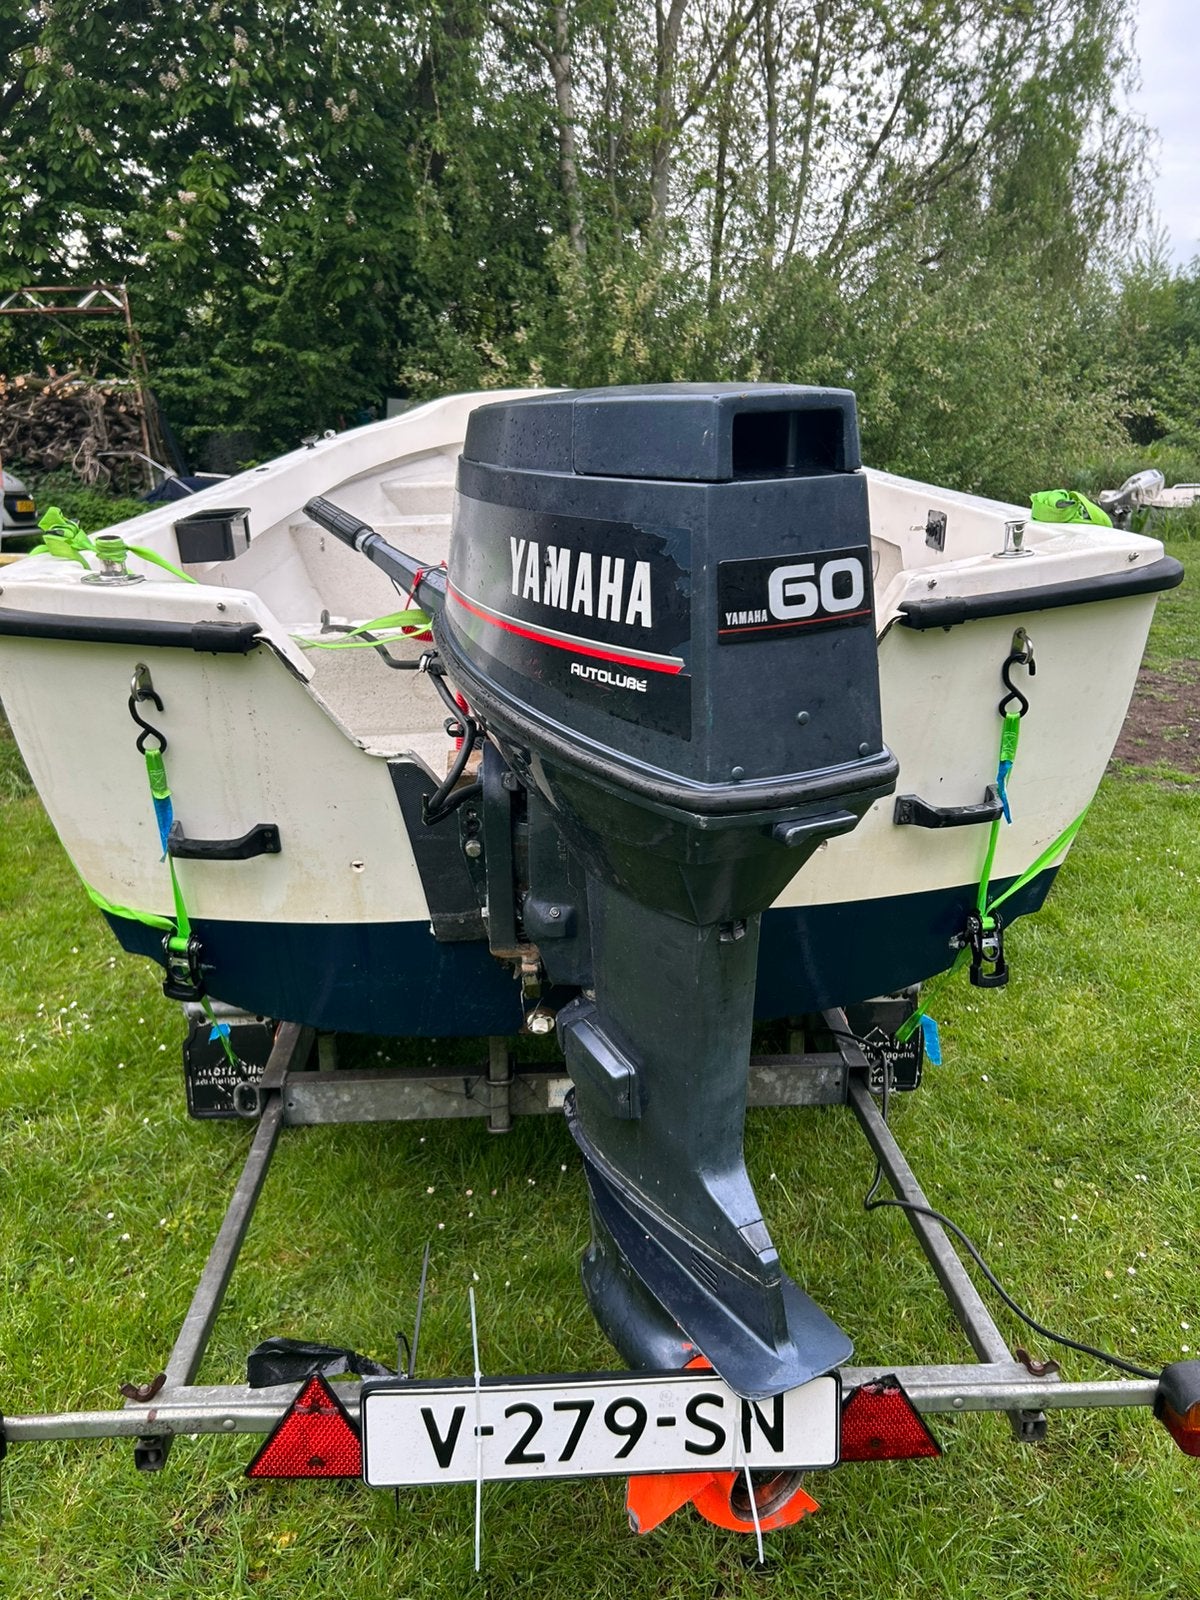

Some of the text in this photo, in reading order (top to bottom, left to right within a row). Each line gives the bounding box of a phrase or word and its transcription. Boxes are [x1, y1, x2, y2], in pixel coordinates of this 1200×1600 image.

[510, 536, 652, 628] YAMAHA
[725, 557, 864, 625] YAMAHA 60
[570, 662, 647, 692] AUTOLUBE
[421, 1392, 784, 1468] V-279-SN
